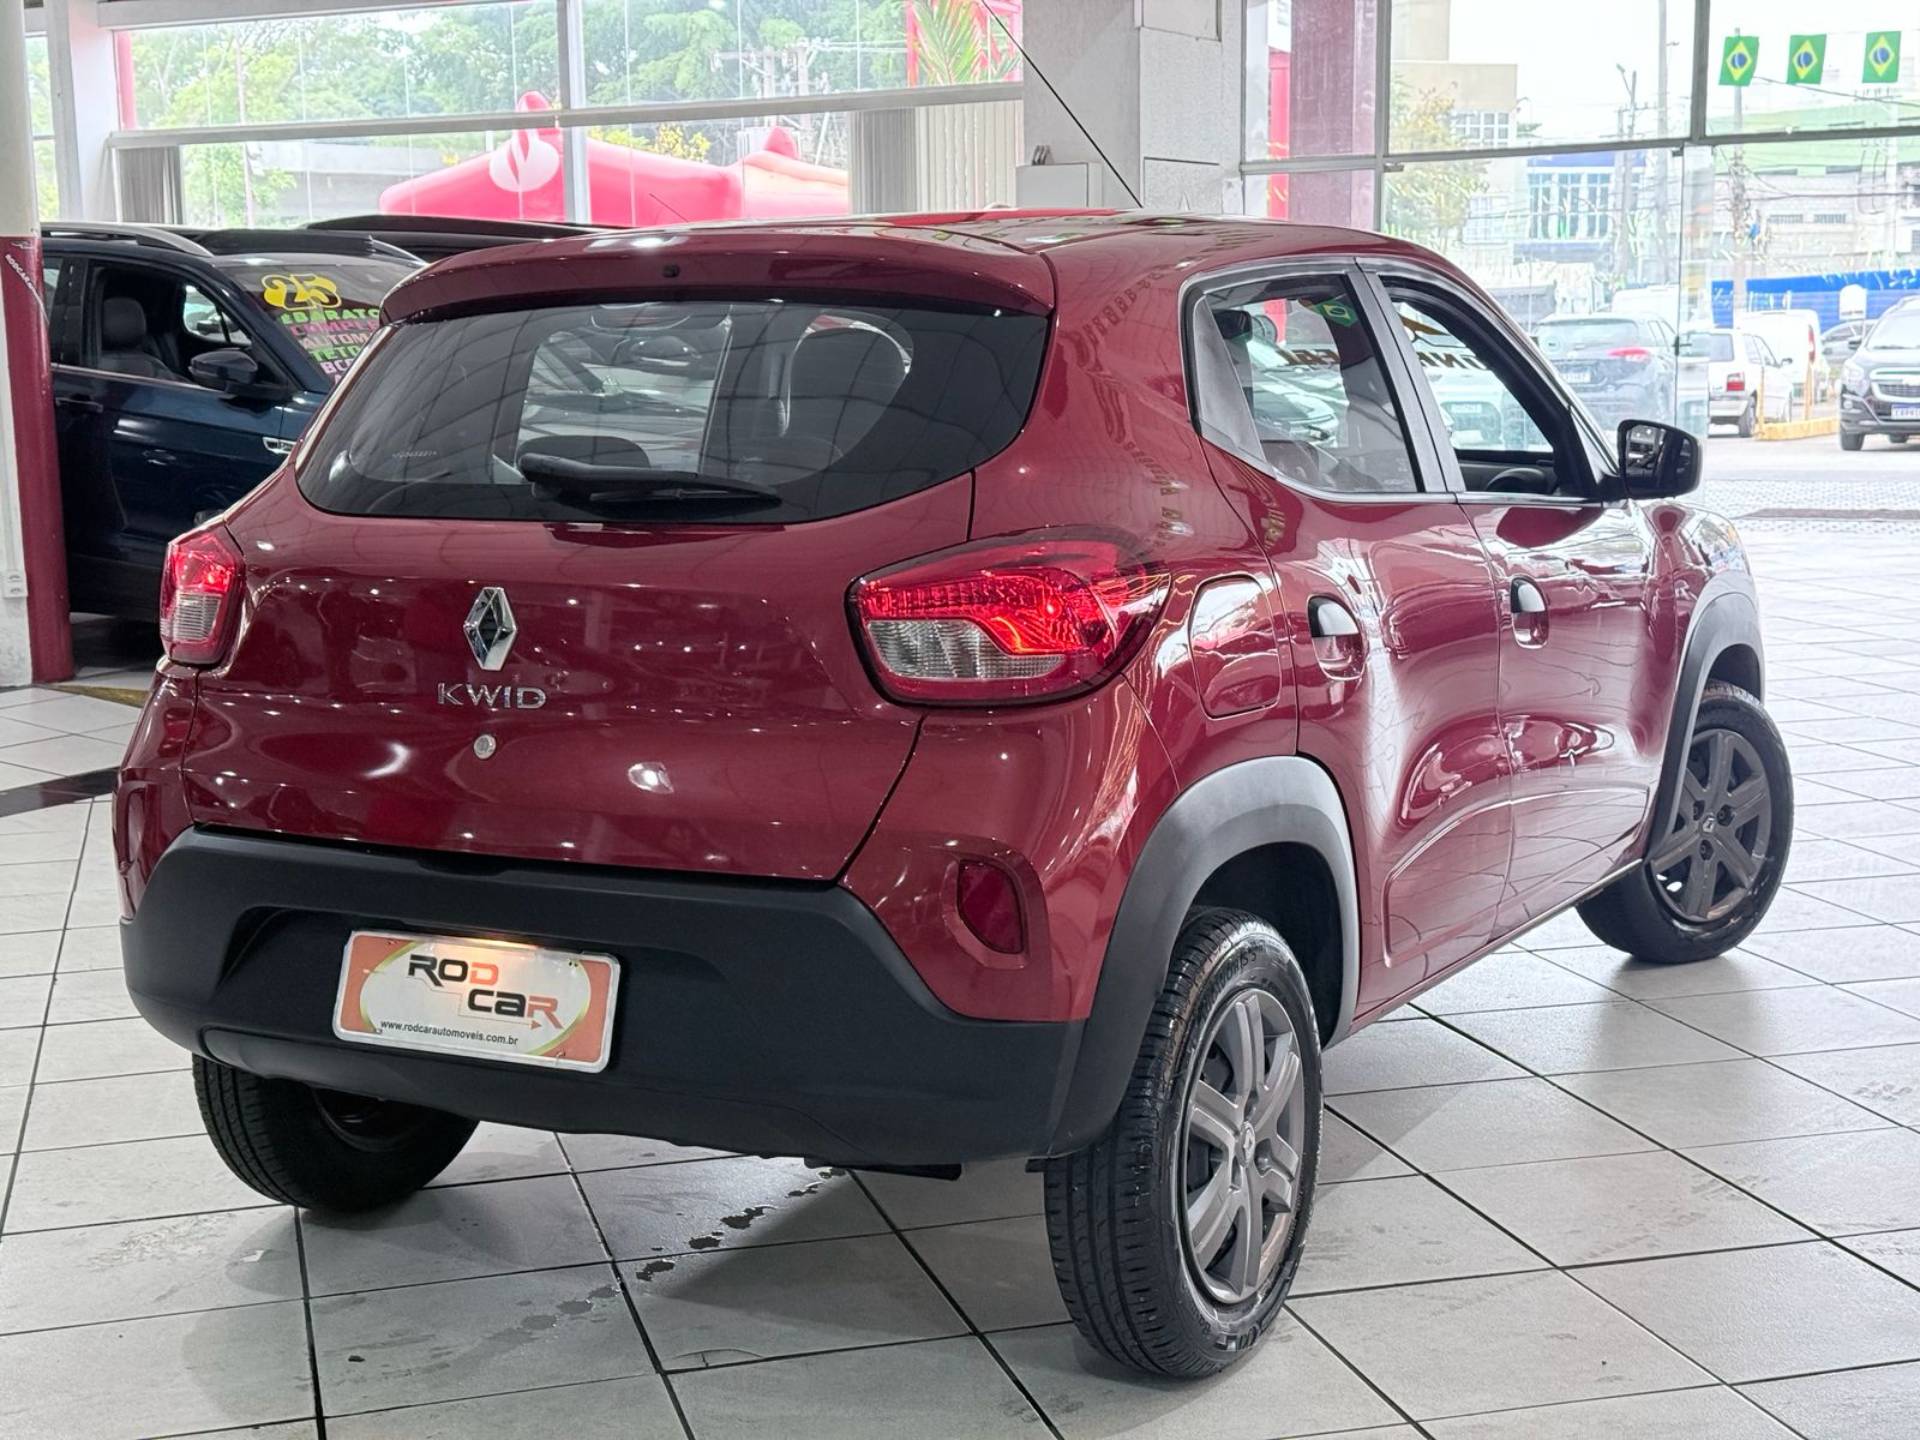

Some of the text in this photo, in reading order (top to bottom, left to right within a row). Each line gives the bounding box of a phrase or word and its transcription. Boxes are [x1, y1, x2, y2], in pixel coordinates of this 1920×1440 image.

[261, 273, 342, 310] 25
[437, 682, 546, 709] KWID
[408, 954, 499, 987] ROD
[380, 1020, 519, 1045] www.rodcarautomoveis.com.br
